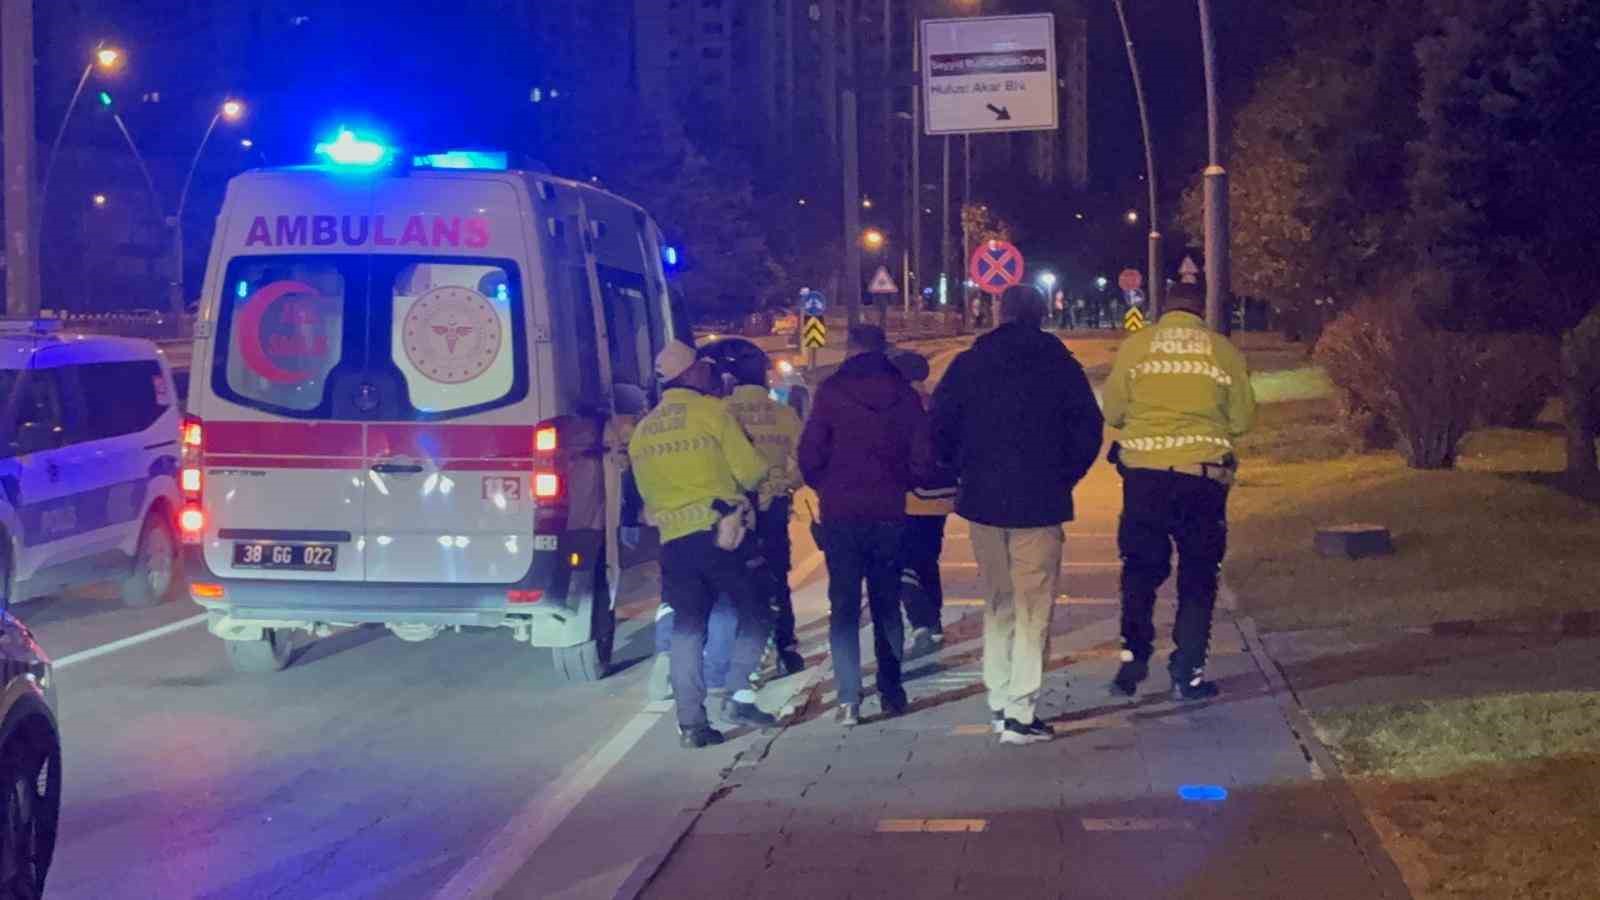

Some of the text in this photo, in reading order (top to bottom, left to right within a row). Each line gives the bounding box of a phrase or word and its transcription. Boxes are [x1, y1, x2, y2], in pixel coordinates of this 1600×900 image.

[246, 215, 490, 247] AMBULANS
[243, 544, 332, 565] 38 GG 022
